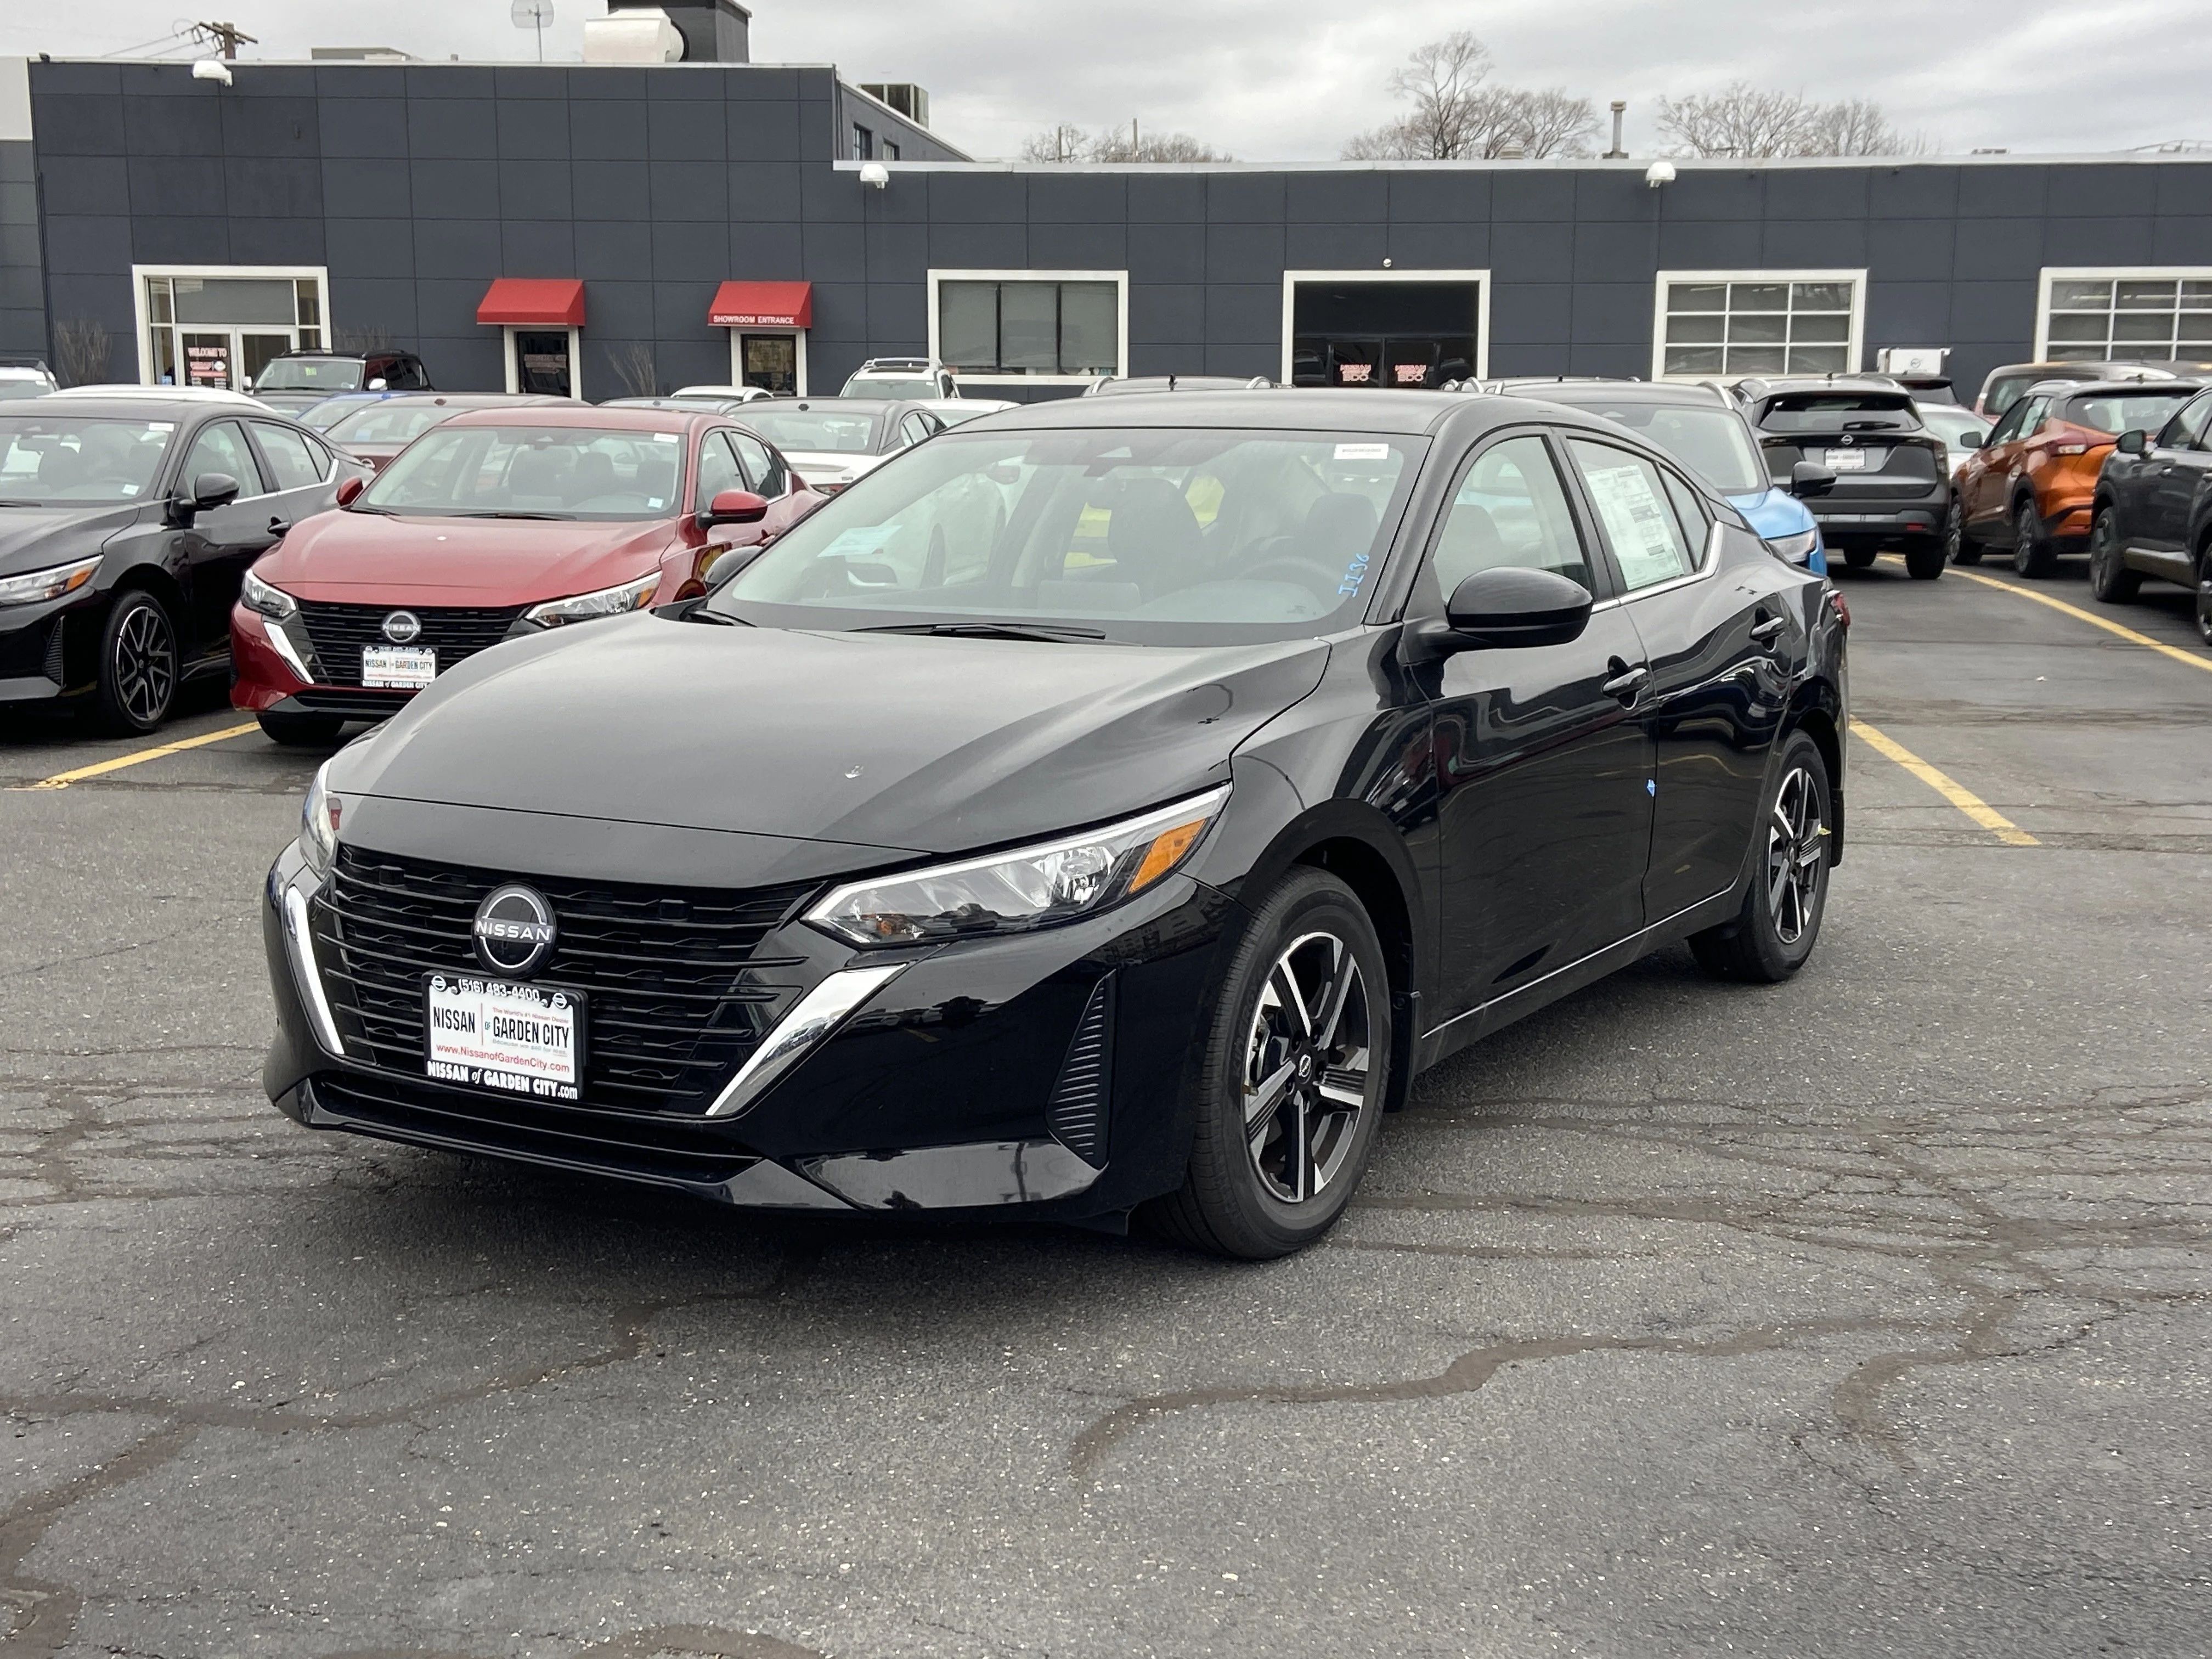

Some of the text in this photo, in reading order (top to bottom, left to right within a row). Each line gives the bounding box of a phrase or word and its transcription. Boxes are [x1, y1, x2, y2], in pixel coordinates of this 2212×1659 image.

[713, 315, 794, 325] SHOWROOM ENTRANCE
[382, 623, 421, 632] NISSAN
[365, 659, 387, 668] NISSAN
[395, 660, 419, 669] GARDEN
[420, 662, 433, 670] CITY
[475, 920, 550, 941] NISSAN
[458, 978, 540, 1002] (516) 483-4400
[433, 1006, 569, 1048] NISSAN OF GARDEN CITY
[436, 1043, 570, 1073] www.NissanofGardenCity.com
[427, 1060, 578, 1100] NISSAN of GARDEN CITY.com
